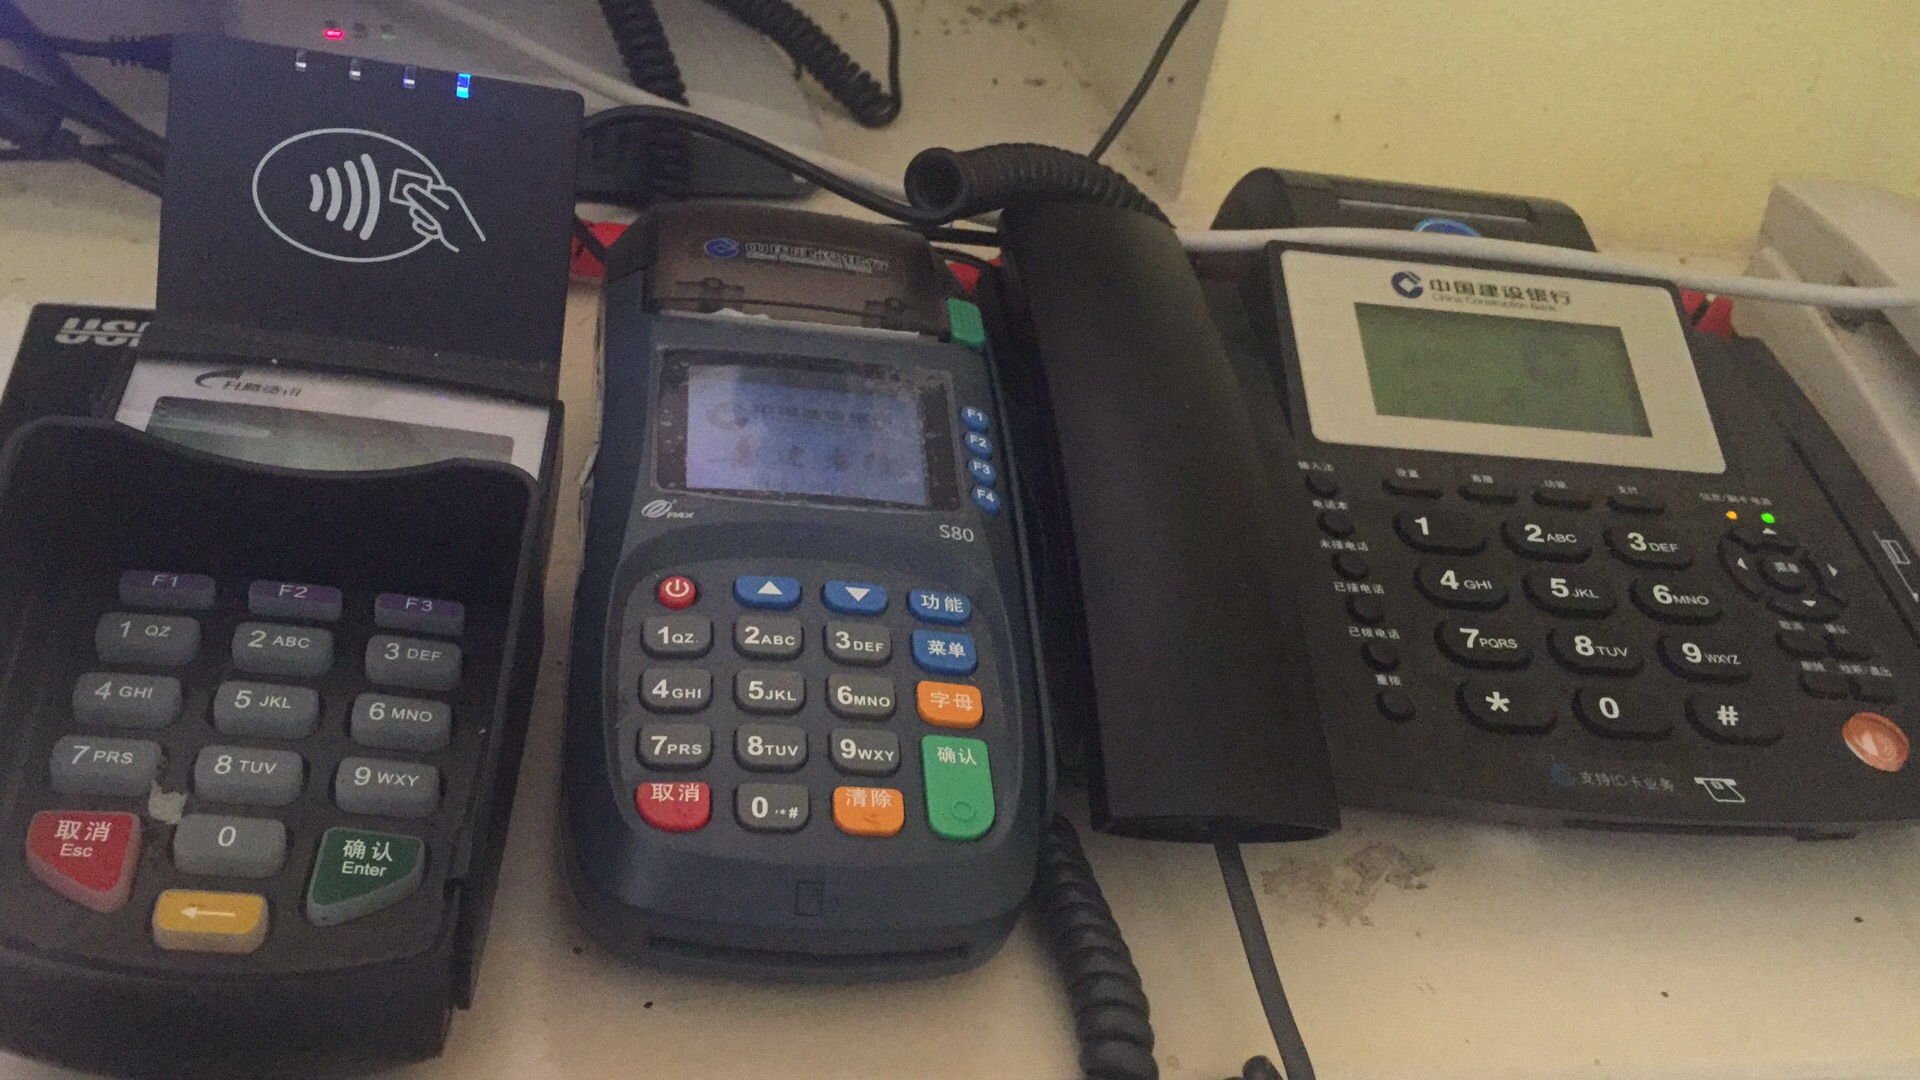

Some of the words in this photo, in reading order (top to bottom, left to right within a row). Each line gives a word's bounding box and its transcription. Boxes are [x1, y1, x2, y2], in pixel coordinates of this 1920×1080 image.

[1429, 278, 1571, 306] 中国建设银行
[966, 408, 983, 422] F1
[969, 434, 987, 448] F2
[973, 460, 991, 475] F3
[976, 488, 995, 502] F4
[938, 524, 975, 543] S80
[1414, 516, 1430, 536] 1
[151, 573, 180, 588] F1
[278, 583, 309, 599] F2
[405, 597, 434, 612] F3
[920, 593, 965, 614] 功能
[926, 639, 967, 659] 菜单
[929, 691, 974, 712] 字母
[1598, 696, 1621, 719] 0
[1716, 704, 1740, 727] #
[936, 745, 978, 766] 确认
[650, 782, 701, 803] 取消
[844, 786, 894, 810] 清除
[54, 819, 112, 842] 取消
[216, 825, 238, 849] 0
[59, 843, 94, 859] Esc
[342, 837, 394, 862] 确认
[340, 859, 388, 879] Enter
